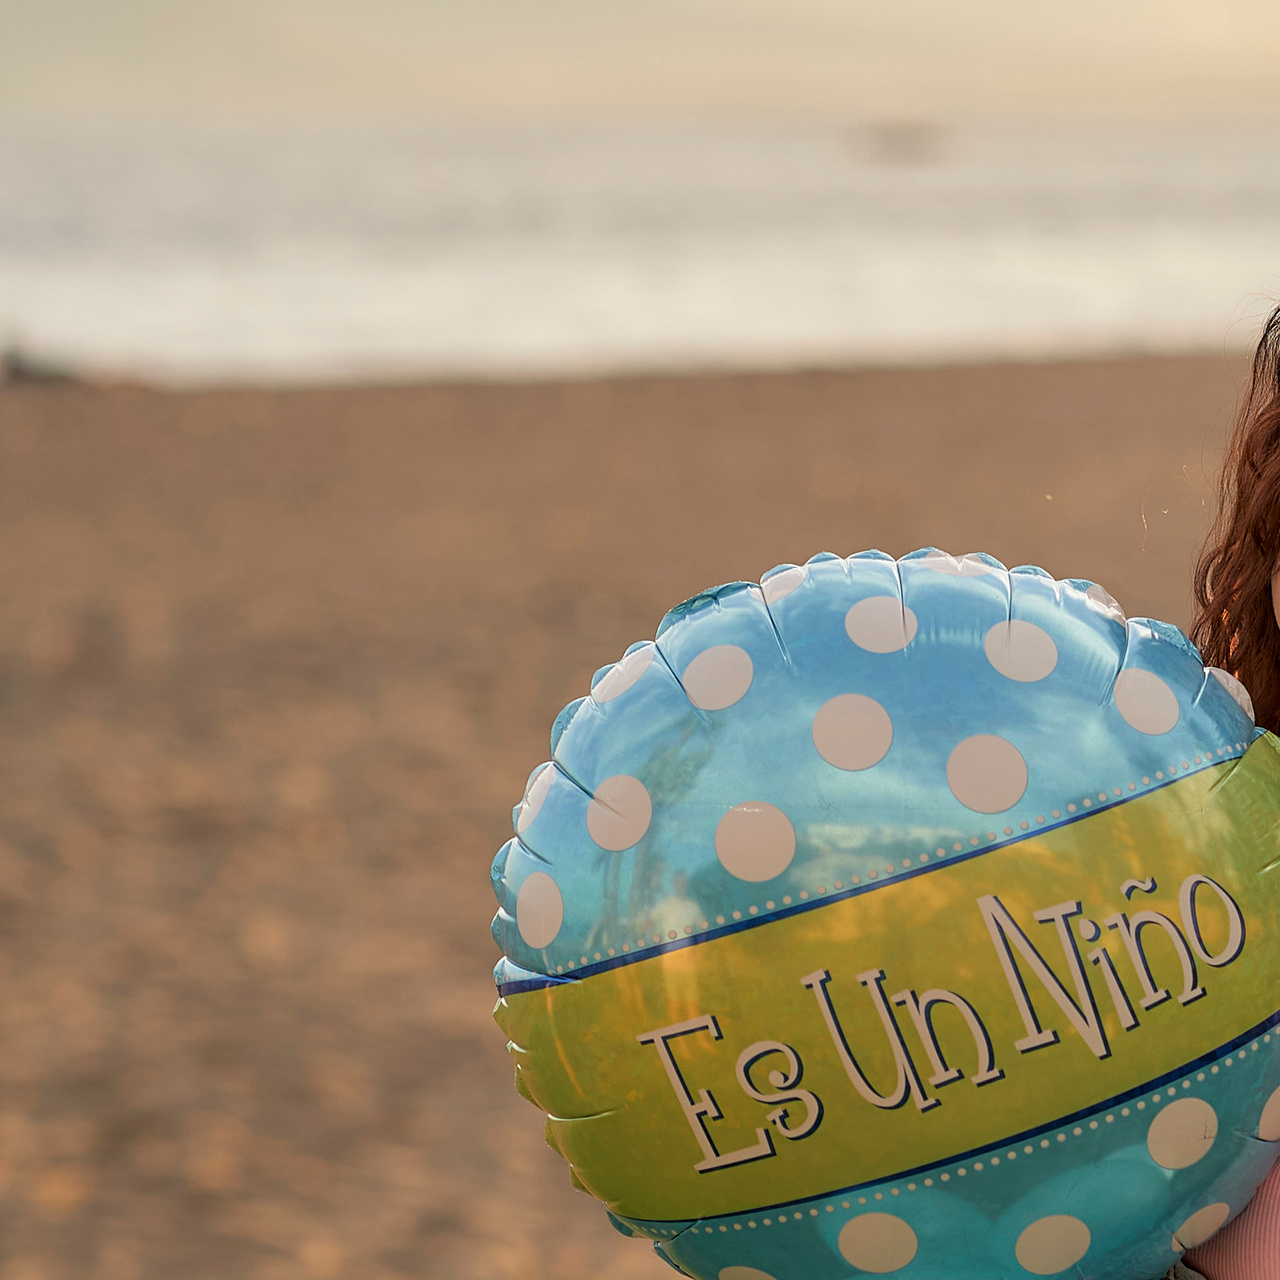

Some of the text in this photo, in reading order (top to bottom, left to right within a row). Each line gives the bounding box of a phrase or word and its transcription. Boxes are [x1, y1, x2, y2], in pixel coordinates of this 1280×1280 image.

[637, 872, 1247, 1174] Es Un Niño
